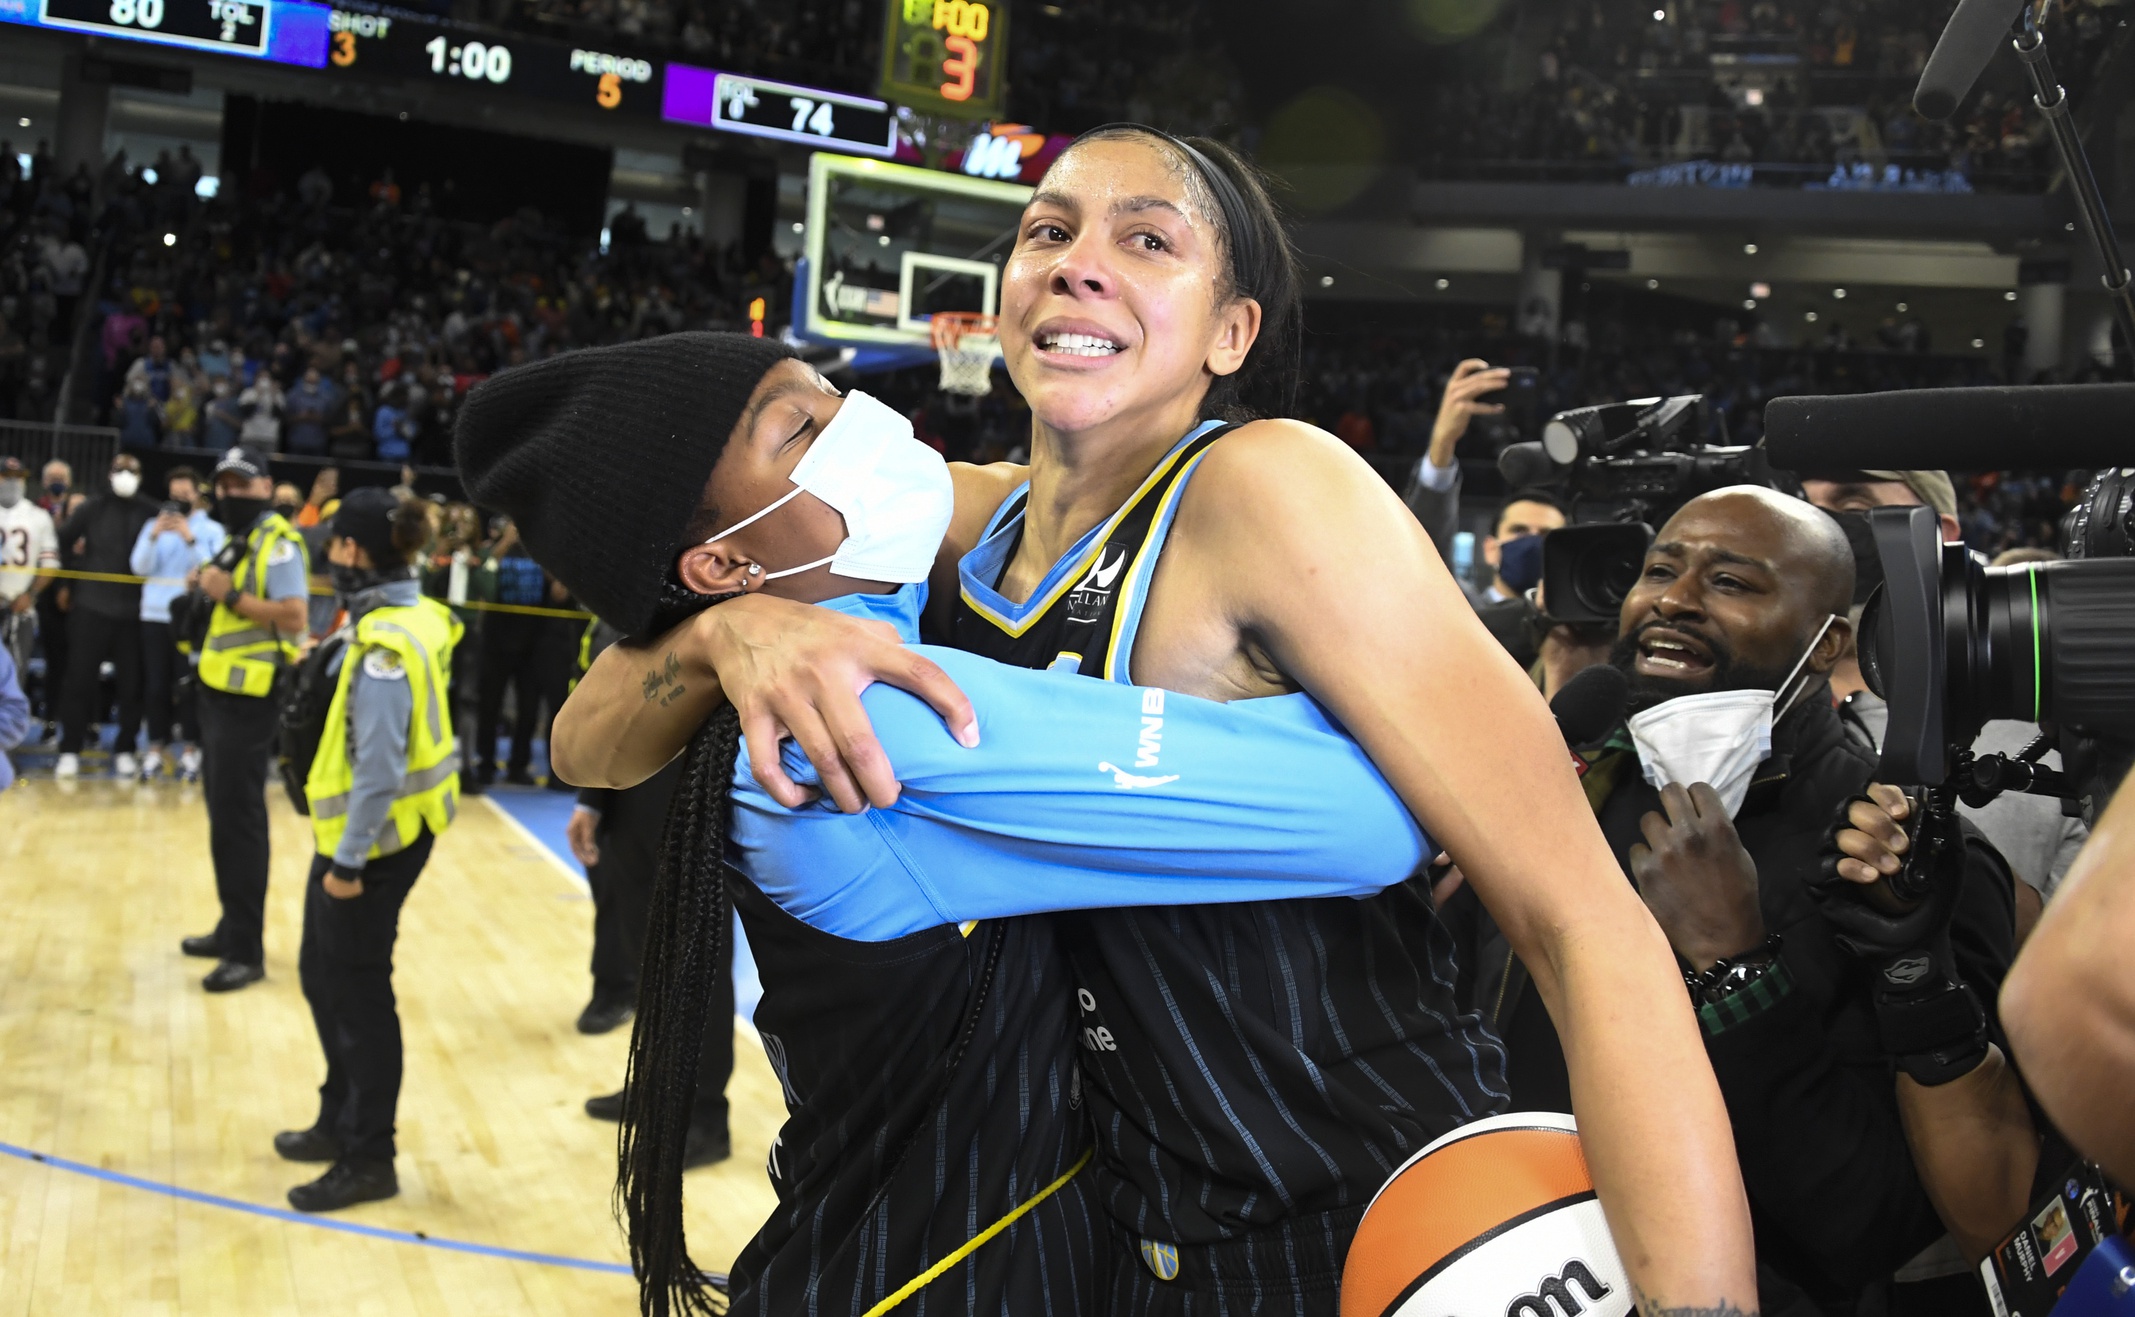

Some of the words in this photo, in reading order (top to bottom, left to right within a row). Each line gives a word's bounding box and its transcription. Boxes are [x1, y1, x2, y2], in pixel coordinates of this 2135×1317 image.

[109, 0, 164, 28] 80
[328, 10, 390, 38] SHOT
[331, 31, 356, 66] 3
[426, 36, 511, 84] 1:00
[570, 49, 652, 83] PERIOD
[941, 36, 977, 101] 3
[597, 73, 621, 108] 5
[790, 97, 834, 136] 74
[1135, 688, 1164, 767] WNB
[2014, 1237, 2033, 1282] MURPHY
[2020, 1231, 2036, 1271] DANIEL
